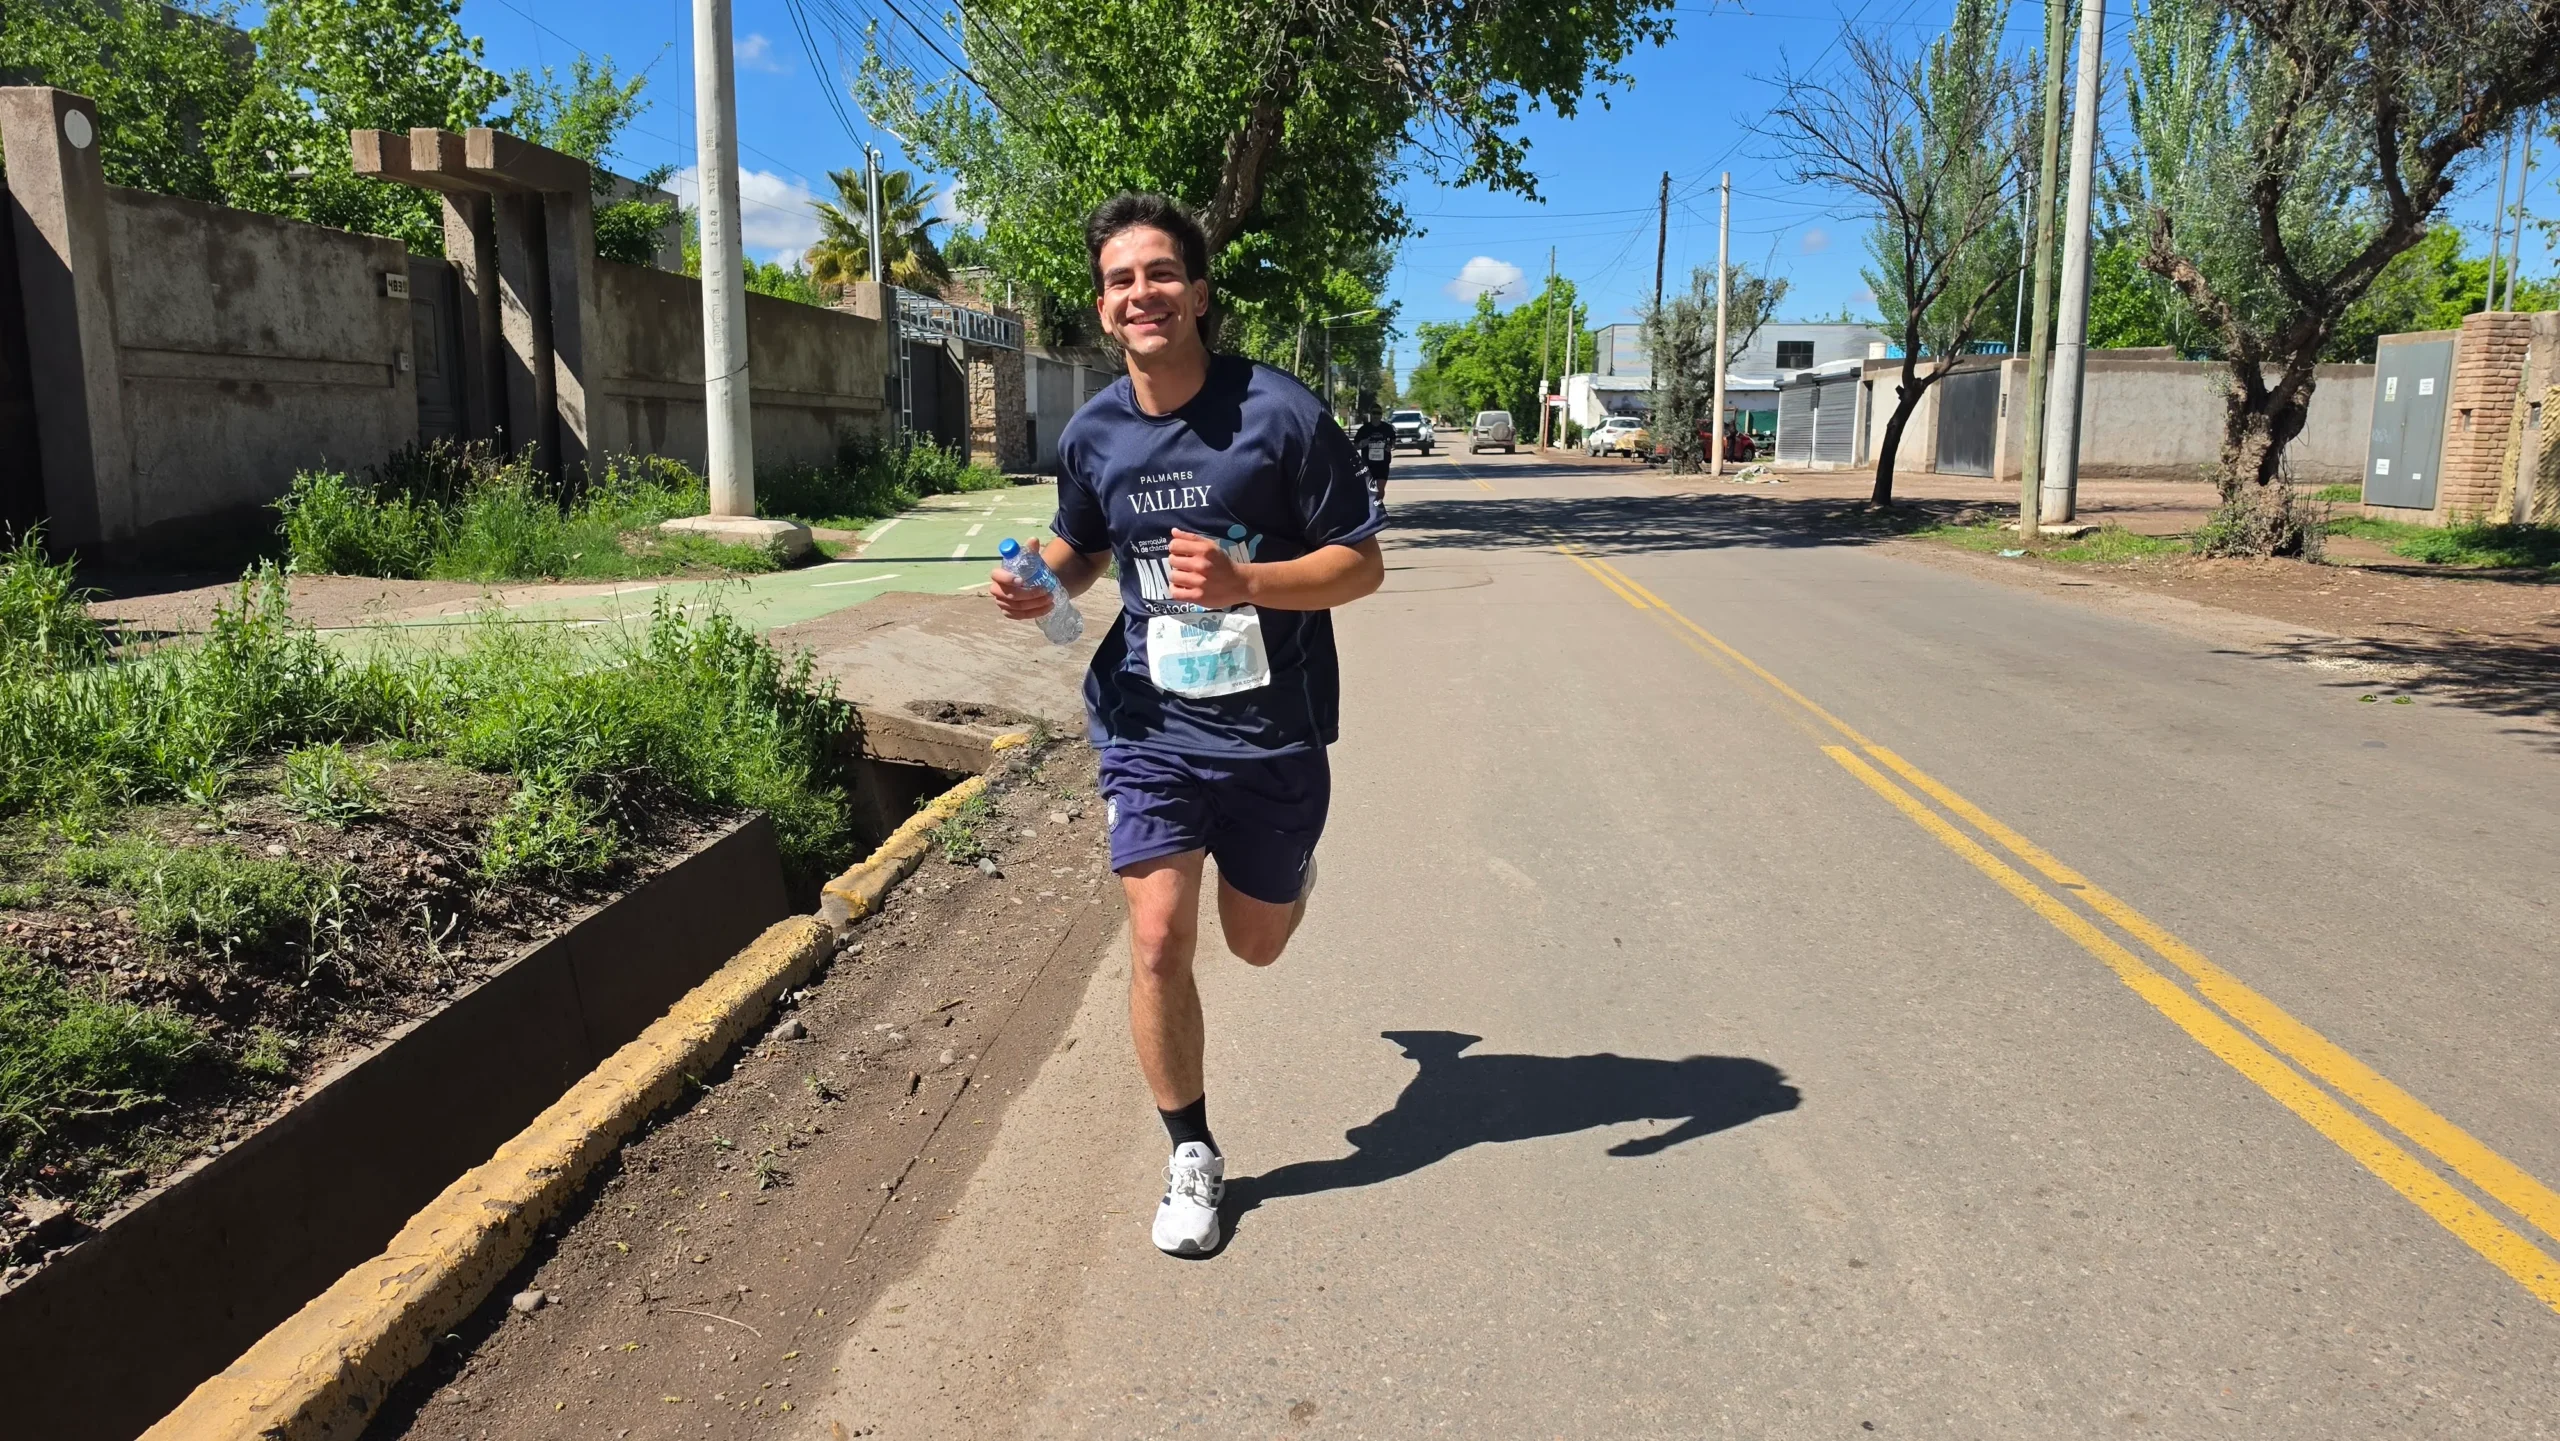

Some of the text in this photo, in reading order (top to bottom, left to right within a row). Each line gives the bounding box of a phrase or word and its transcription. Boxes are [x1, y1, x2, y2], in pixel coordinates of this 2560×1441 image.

[1140, 471, 1193, 484] PALMARES
[1128, 485, 1212, 514] VALLEY
[1149, 544, 1170, 552] chacra
